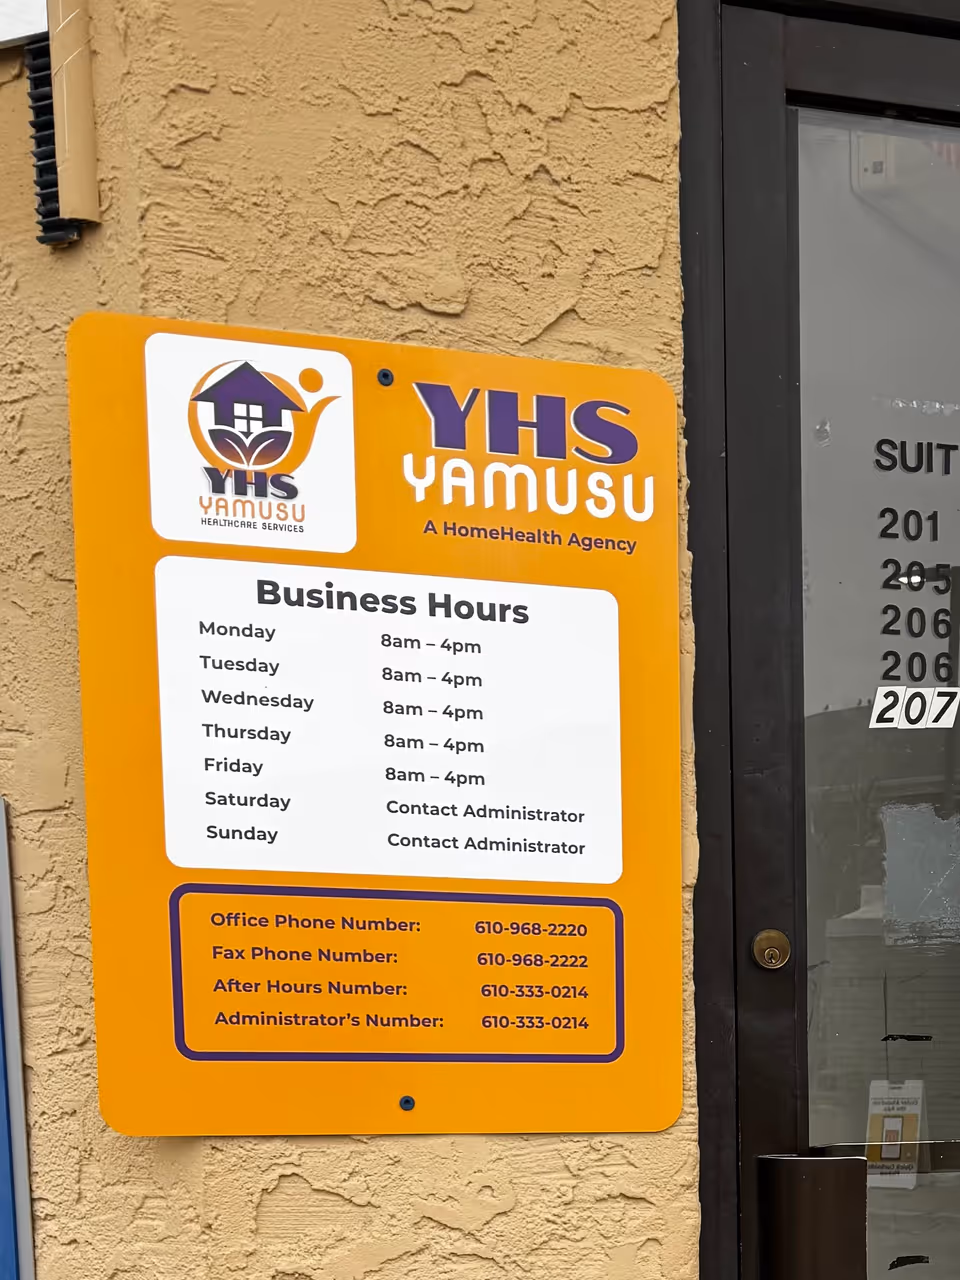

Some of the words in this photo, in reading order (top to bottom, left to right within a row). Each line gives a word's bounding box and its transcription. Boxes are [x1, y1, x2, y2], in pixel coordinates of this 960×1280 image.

[413, 382, 638, 466] YHS
[203, 467, 298, 500] YHS
[403, 453, 654, 522] YAMUSU
[199, 496, 306, 522] YAMUSU
[201, 517, 258, 529] HEALTHCARE
[262, 523, 304, 533] SERVICES
[878, 507, 938, 542] 201
[423, 520, 437, 534] A
[443, 522, 562, 545] HomeHealth
[567, 533, 637, 555] Agency
[257, 580, 417, 615] Business
[428, 593, 529, 624] Hours
[199, 621, 276, 642] Monday
[381, 634, 421, 649] 8am
[440, 638, 482, 655] 4pm
[199, 655, 280, 676] Tuesday
[382, 667, 422, 683] 8am
[441, 672, 483, 688] 4pm
[201, 689, 314, 712] Wednesday
[383, 701, 423, 716] 8am
[442, 705, 484, 721] 4pm
[874, 690, 958, 726] 207
[202, 724, 291, 744] Thursday
[384, 734, 424, 749] 8am
[443, 738, 485, 755] 4pm
[204, 758, 263, 777] Friday
[385, 767, 425, 782] 8am
[444, 771, 486, 787] 4pm
[205, 792, 291, 811] Saturday
[386, 800, 459, 817] Contact
[463, 804, 586, 823] Administrator
[206, 825, 279, 844] Sunday
[387, 833, 460, 849] Contact
[464, 836, 586, 855] Administrator
[210, 912, 269, 928] Office
[274, 914, 336, 930] Phone
[341, 916, 421, 932] Number:
[474, 920, 588, 937] 610-968-2220
[212, 946, 245, 960] Fax
[251, 947, 312, 961] Phone
[318, 948, 398, 964] Number:
[477, 952, 589, 968] 610-968-2222
[213, 978, 261, 993] After
[267, 980, 322, 994] Hours
[327, 981, 408, 996] Number:
[481, 984, 589, 999] 610-333-0214
[365, 1014, 444, 1028] Number:
[481, 1015, 589, 1030] 610-333-0214
